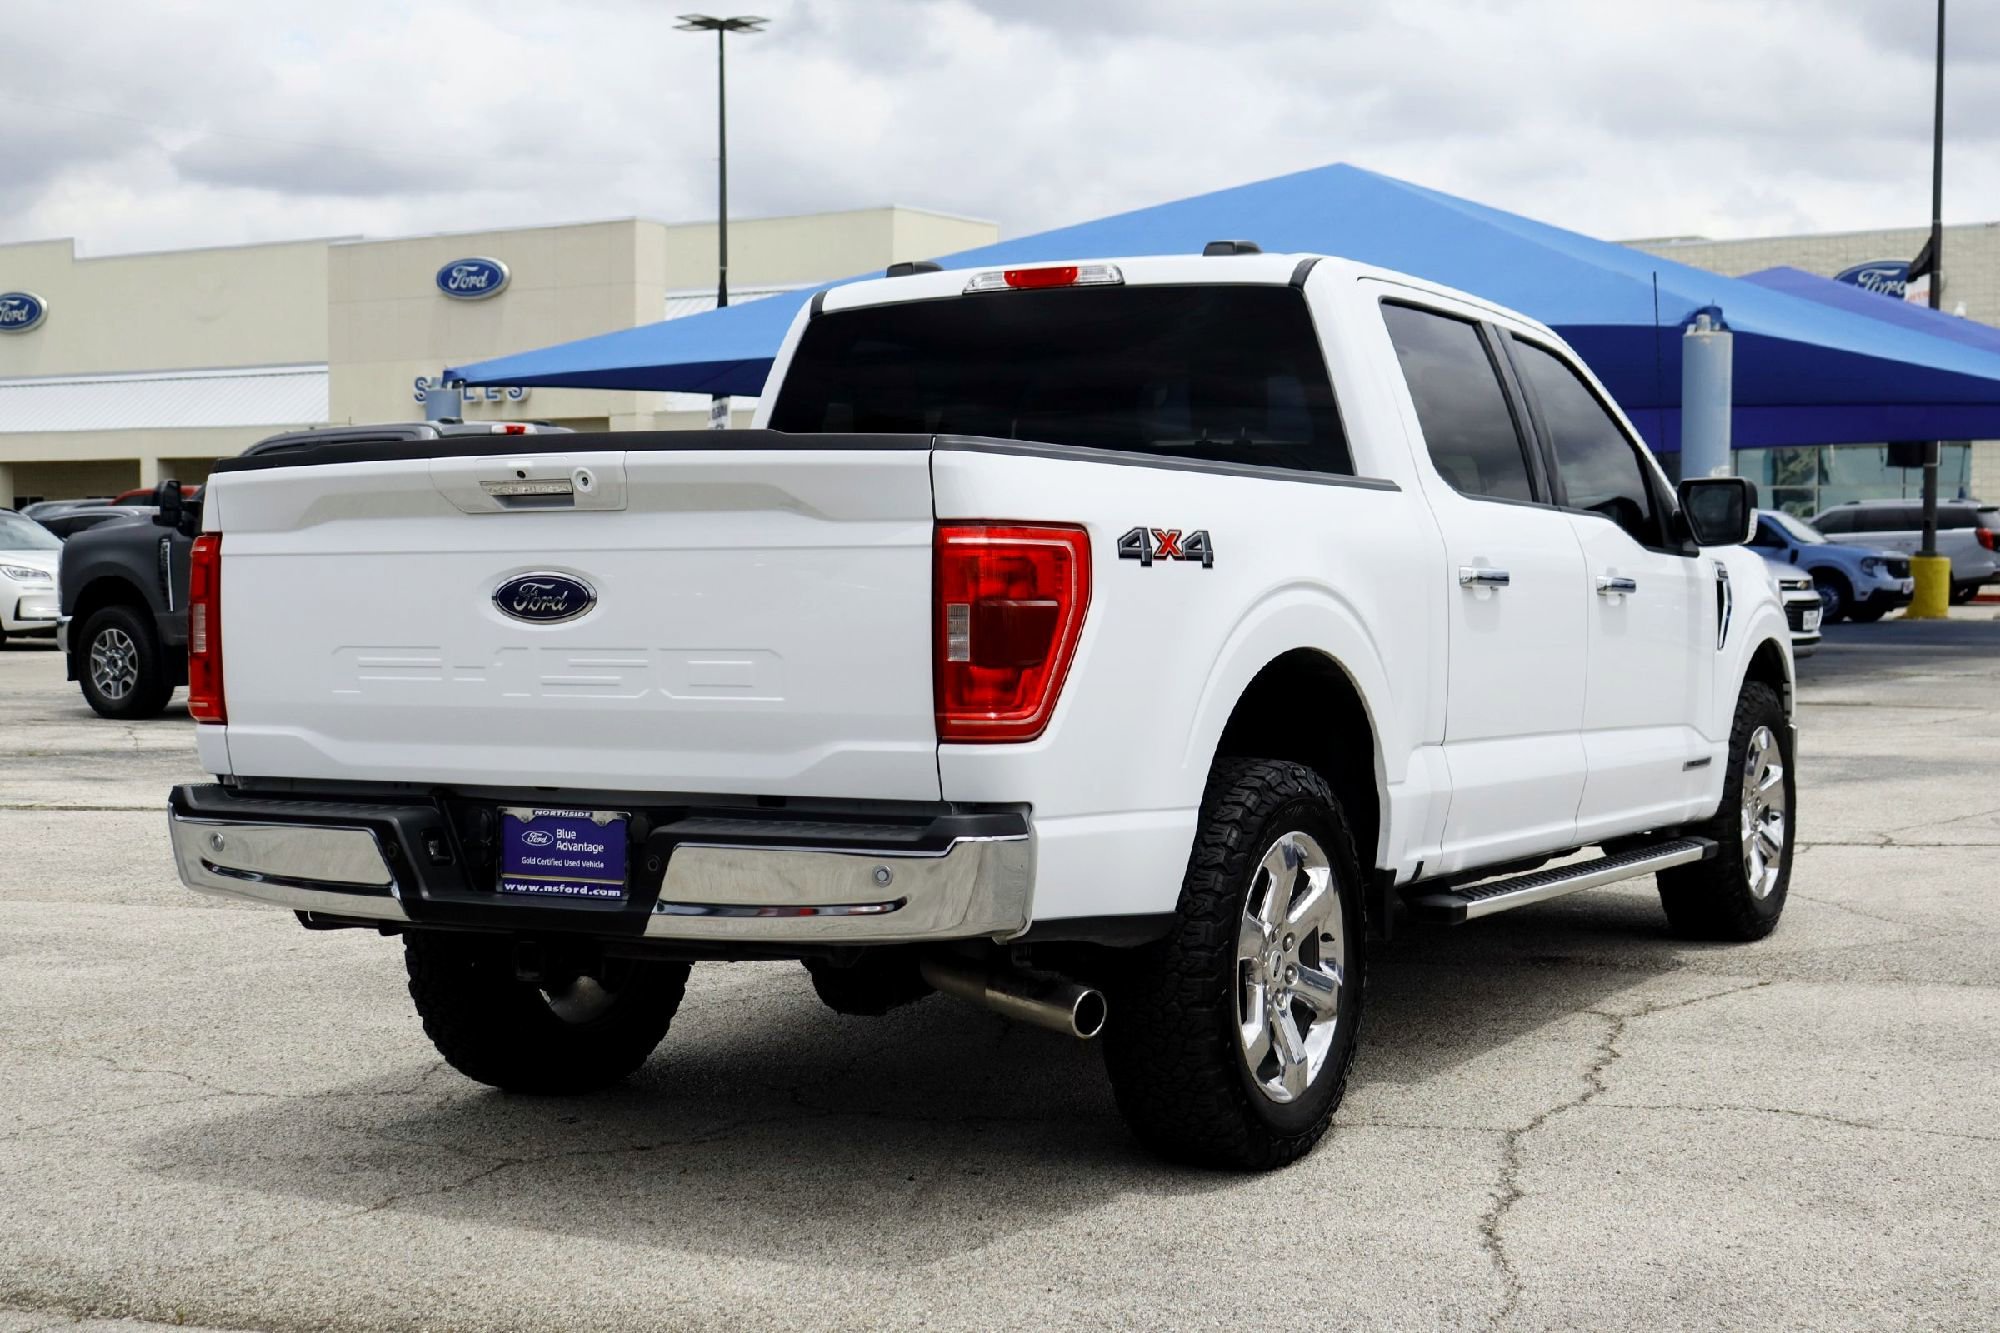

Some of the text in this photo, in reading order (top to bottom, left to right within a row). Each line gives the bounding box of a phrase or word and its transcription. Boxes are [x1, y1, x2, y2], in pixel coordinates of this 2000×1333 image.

[448, 265, 489, 289] Ford
[414, 376, 526, 402] SLES
[513, 583, 568, 611] Ford
[527, 832, 548, 843] Ford
[556, 828, 576, 839] Blue
[556, 841, 604, 854] Advantage
[522, 857, 604, 868] Gold Certified Used Vehicle
[504, 883, 621, 897] www.nsford.com
